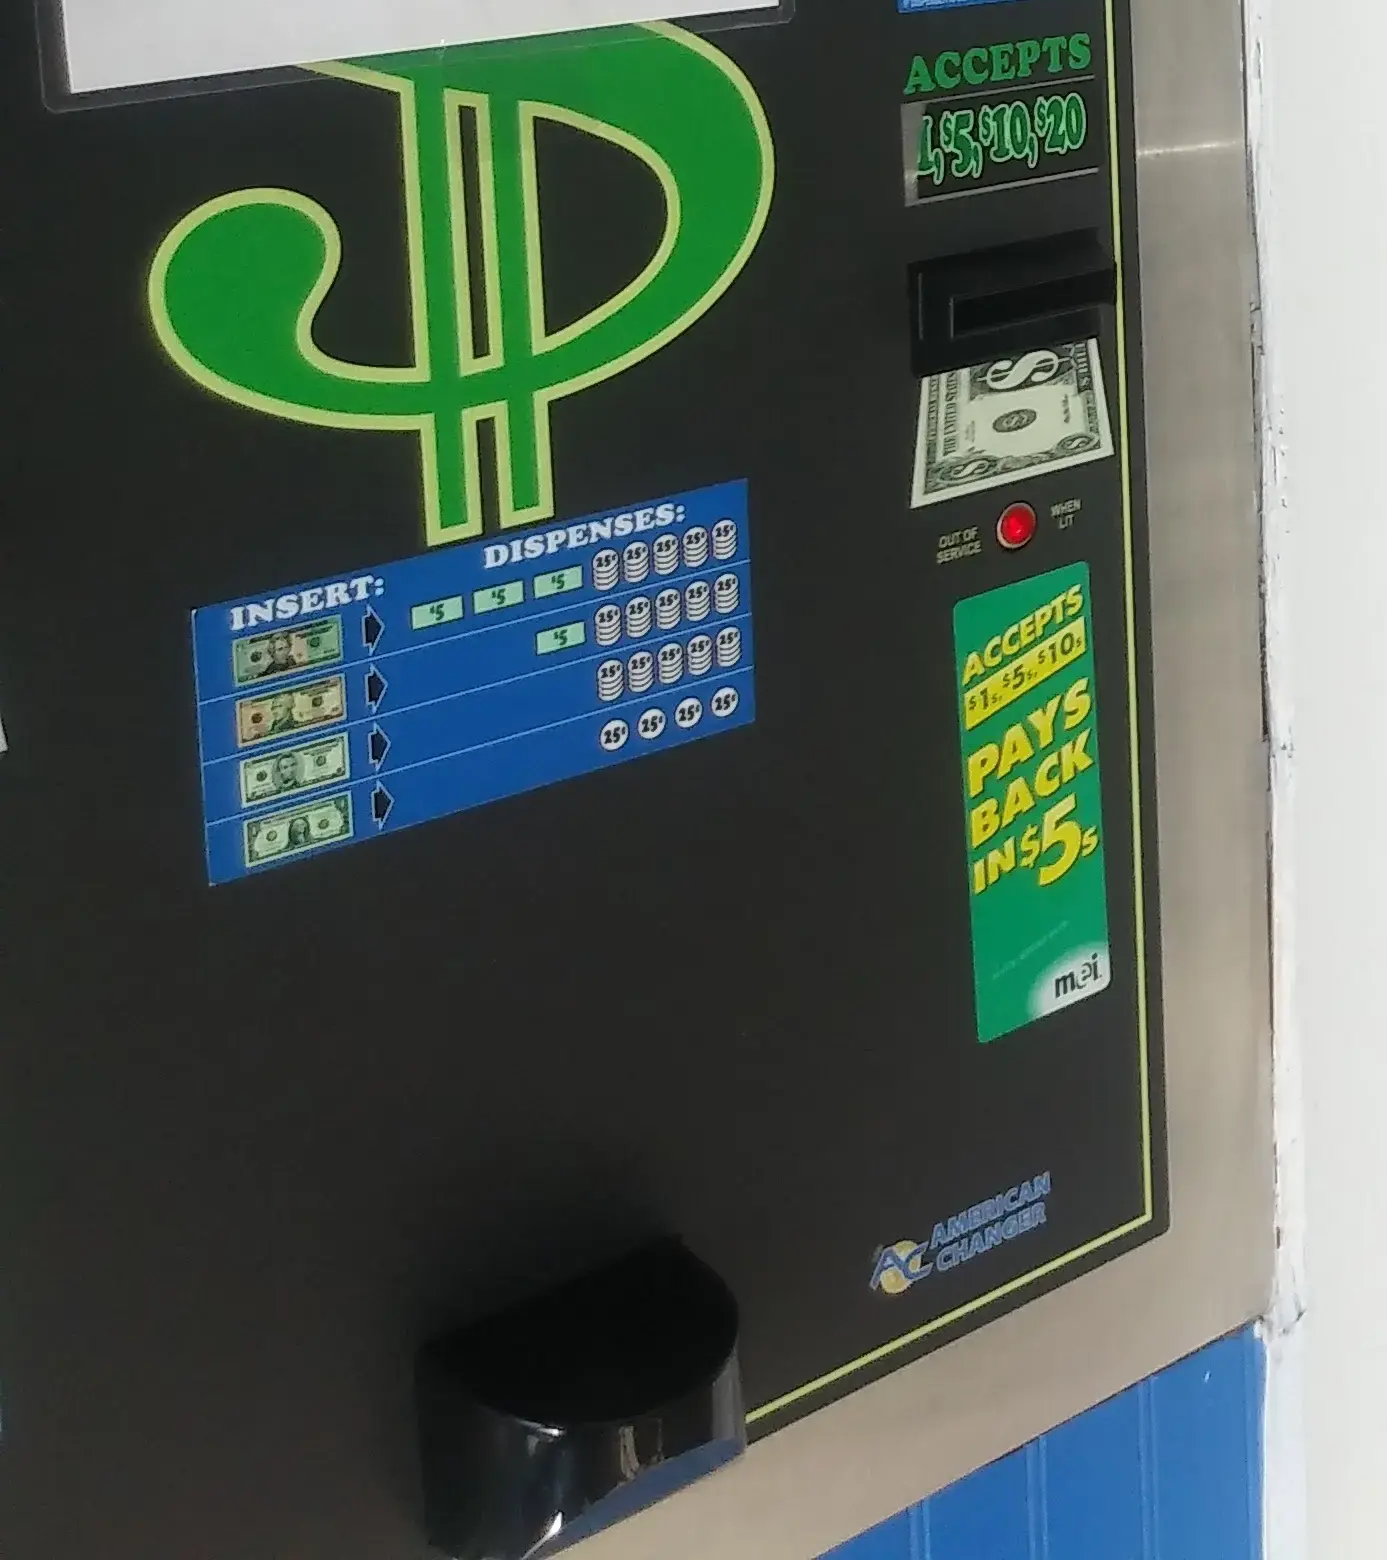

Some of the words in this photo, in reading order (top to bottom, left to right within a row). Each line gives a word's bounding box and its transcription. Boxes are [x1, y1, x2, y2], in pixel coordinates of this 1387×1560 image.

[903, 32, 1092, 95] ACCEPTS
[483, 502, 687, 569] DISPENSES:
[939, 530, 960, 549] OUT
[961, 526, 978, 544] OF
[1051, 498, 1081, 518] WHEN
[1059, 512, 1075, 529] LIT
[937, 541, 982, 564] SERVICE
[230, 574, 386, 632] INSERT:
[961, 583, 1084, 687] ACCEPTS
[1037, 631, 1082, 664] $10s
[967, 676, 1092, 799] PAYS
[970, 727, 1093, 849] BACK
[972, 835, 1017, 895] IN
[1055, 951, 1103, 998] mei
[930, 1170, 1052, 1250] AMERICAN
[936, 1201, 1048, 1272] CHANGER
